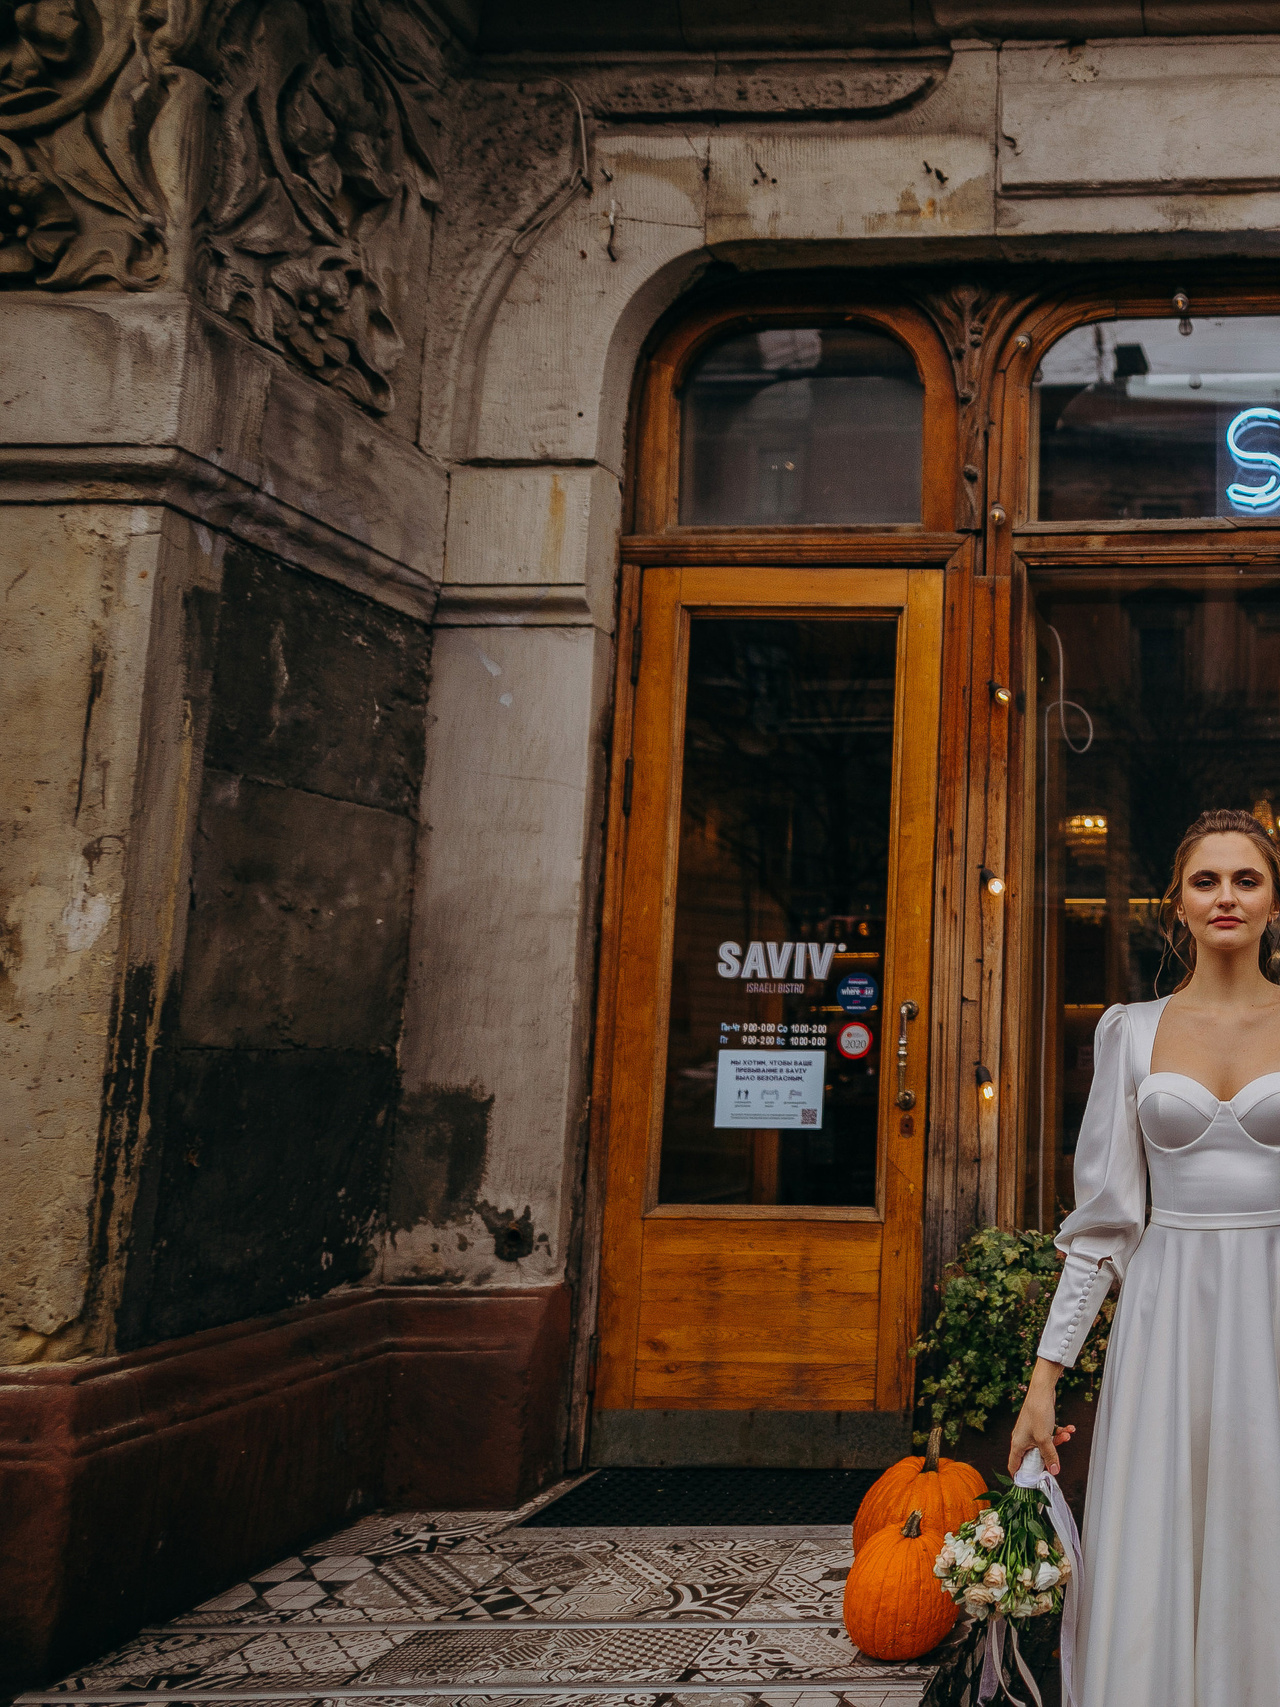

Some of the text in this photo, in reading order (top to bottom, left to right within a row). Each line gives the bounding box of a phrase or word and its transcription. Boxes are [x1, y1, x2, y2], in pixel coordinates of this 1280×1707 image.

[746, 982, 805, 994] ISRAELI BISTRO
[845, 1039, 867, 1049] 2020
